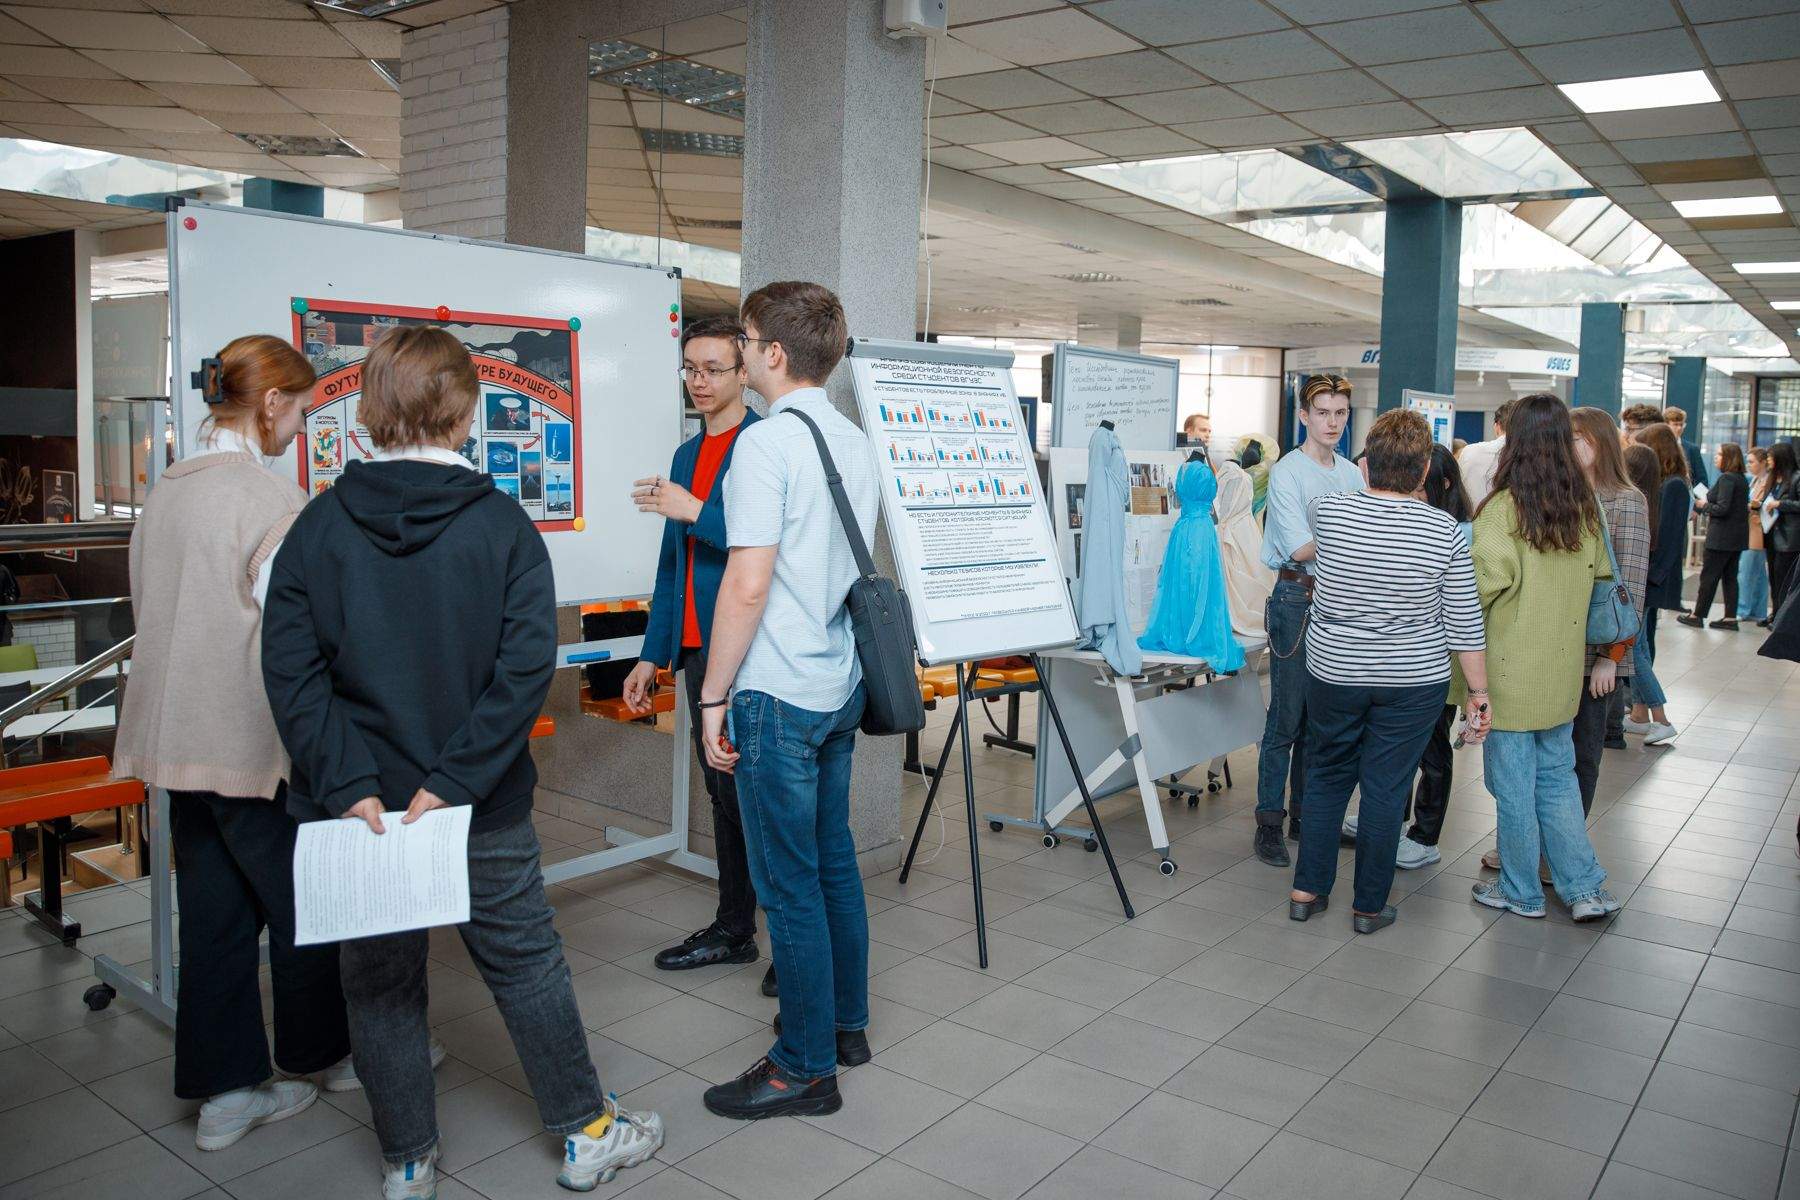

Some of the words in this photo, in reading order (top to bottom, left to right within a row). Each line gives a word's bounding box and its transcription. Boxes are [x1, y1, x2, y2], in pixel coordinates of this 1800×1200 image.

[1361, 350, 1380, 363] ВГ
[871, 362, 942, 373] ИНФОРМАЦИОННОЙ
[943, 367, 996, 377] БЕЗОПАСНОСТИ
[498, 367, 558, 400] БУДУЩЕГО
[918, 373, 960, 382] СТУДЕНТОВ
